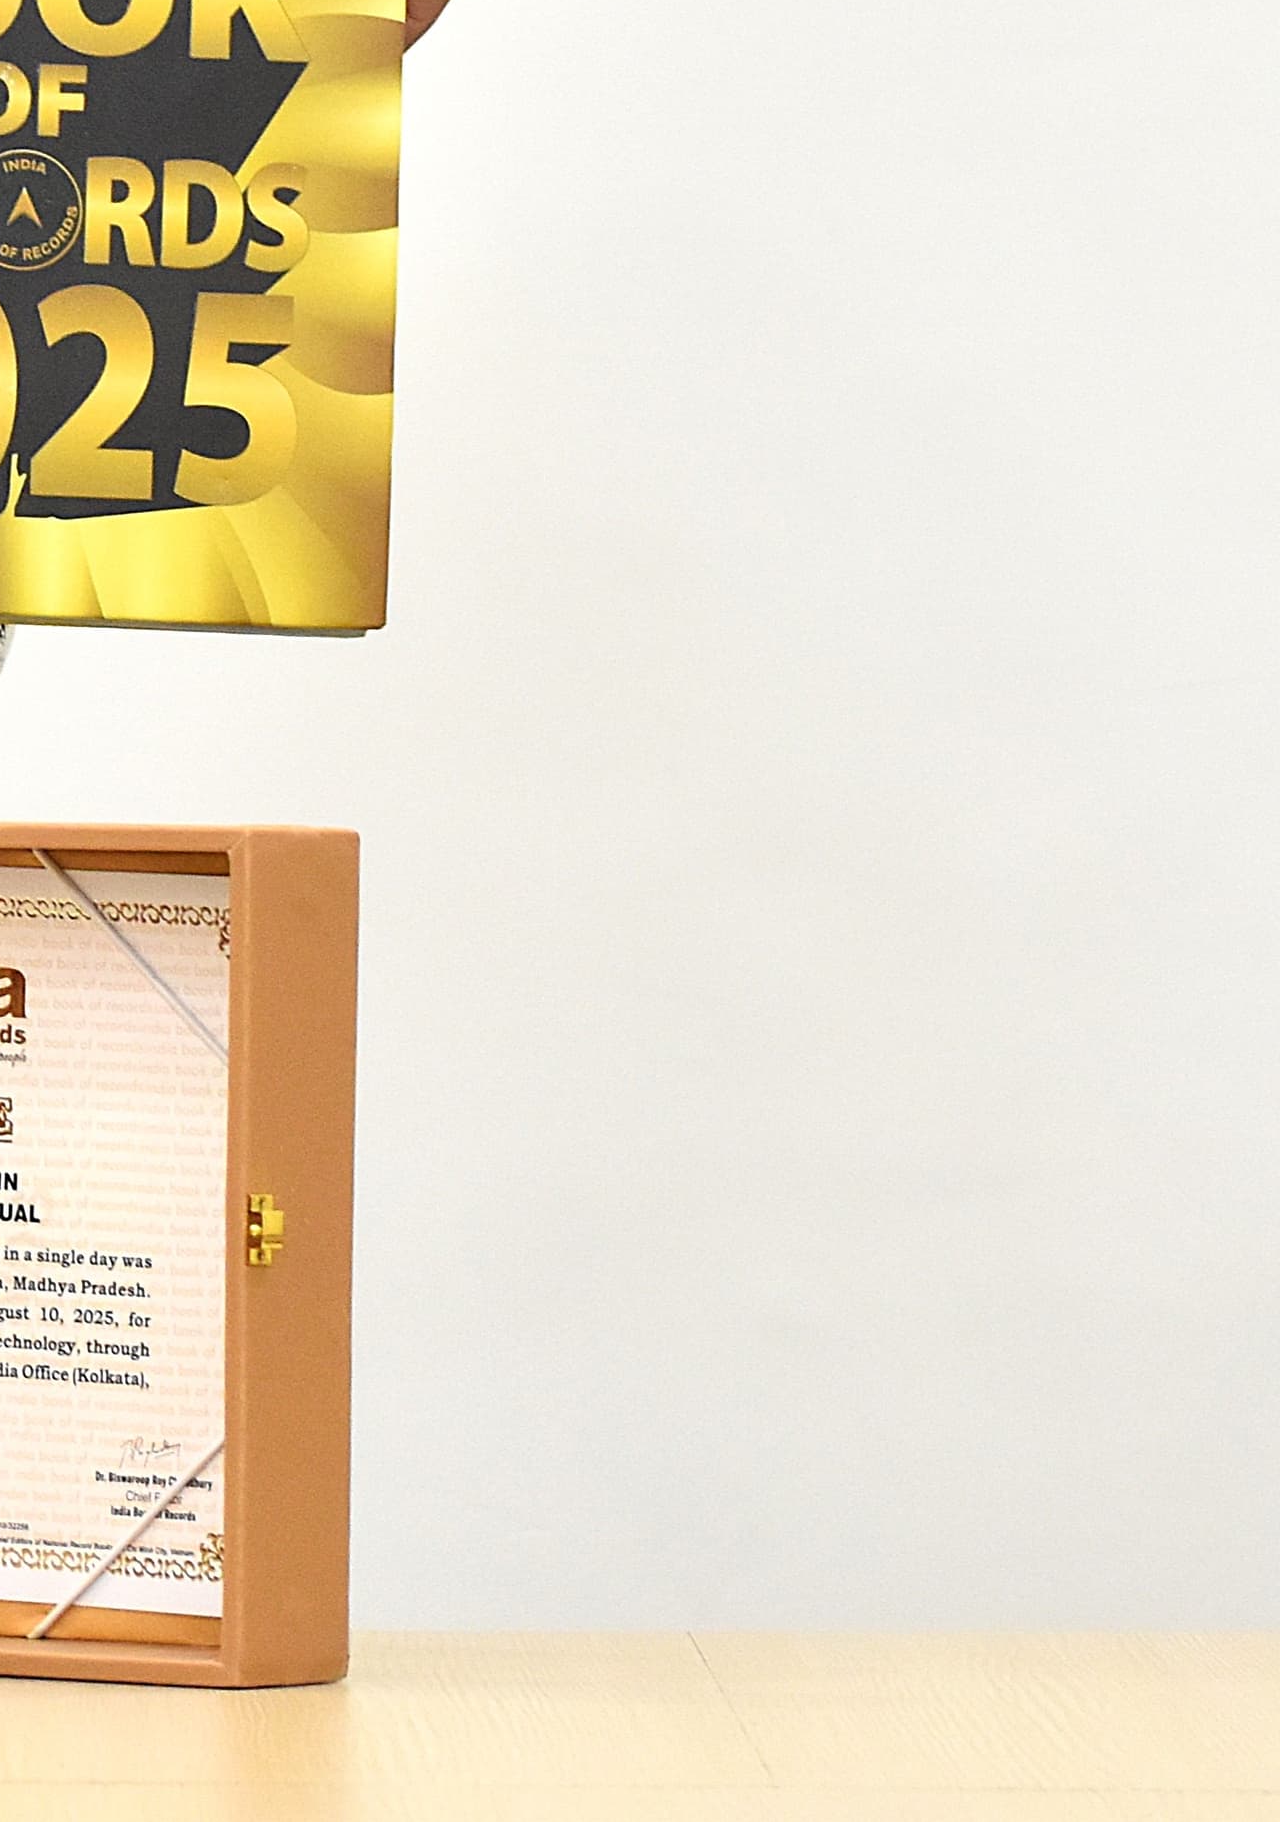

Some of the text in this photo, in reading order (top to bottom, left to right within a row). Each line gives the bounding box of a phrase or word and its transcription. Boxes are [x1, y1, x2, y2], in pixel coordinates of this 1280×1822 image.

[2, 159, 47, 175] INDIA
[22, 206, 77, 261] RECORDS
[3, 1245, 20, 1261] in
[23, 1251, 33, 1262] a
[36, 1248, 86, 1269] single
[89, 1251, 118, 1271] day
[122, 1256, 153, 1269] was
[13, 1275, 77, 1297] Madhya
[81, 1279, 151, 1298] Pradesh.
[41, 1307, 64, 1324] 10,
[74, 1308, 119, 1327] 2025,
[128, 1311, 151, 1328] for
[86, 1339, 150, 1361] through
[21, 1364, 70, 1383] Office
[72, 1367, 150, 1389] (Kolkata),
[126, 1490, 151, 1502] Chief
[111, 1506, 131, 1517] India
[165, 1509, 196, 1521] Records
